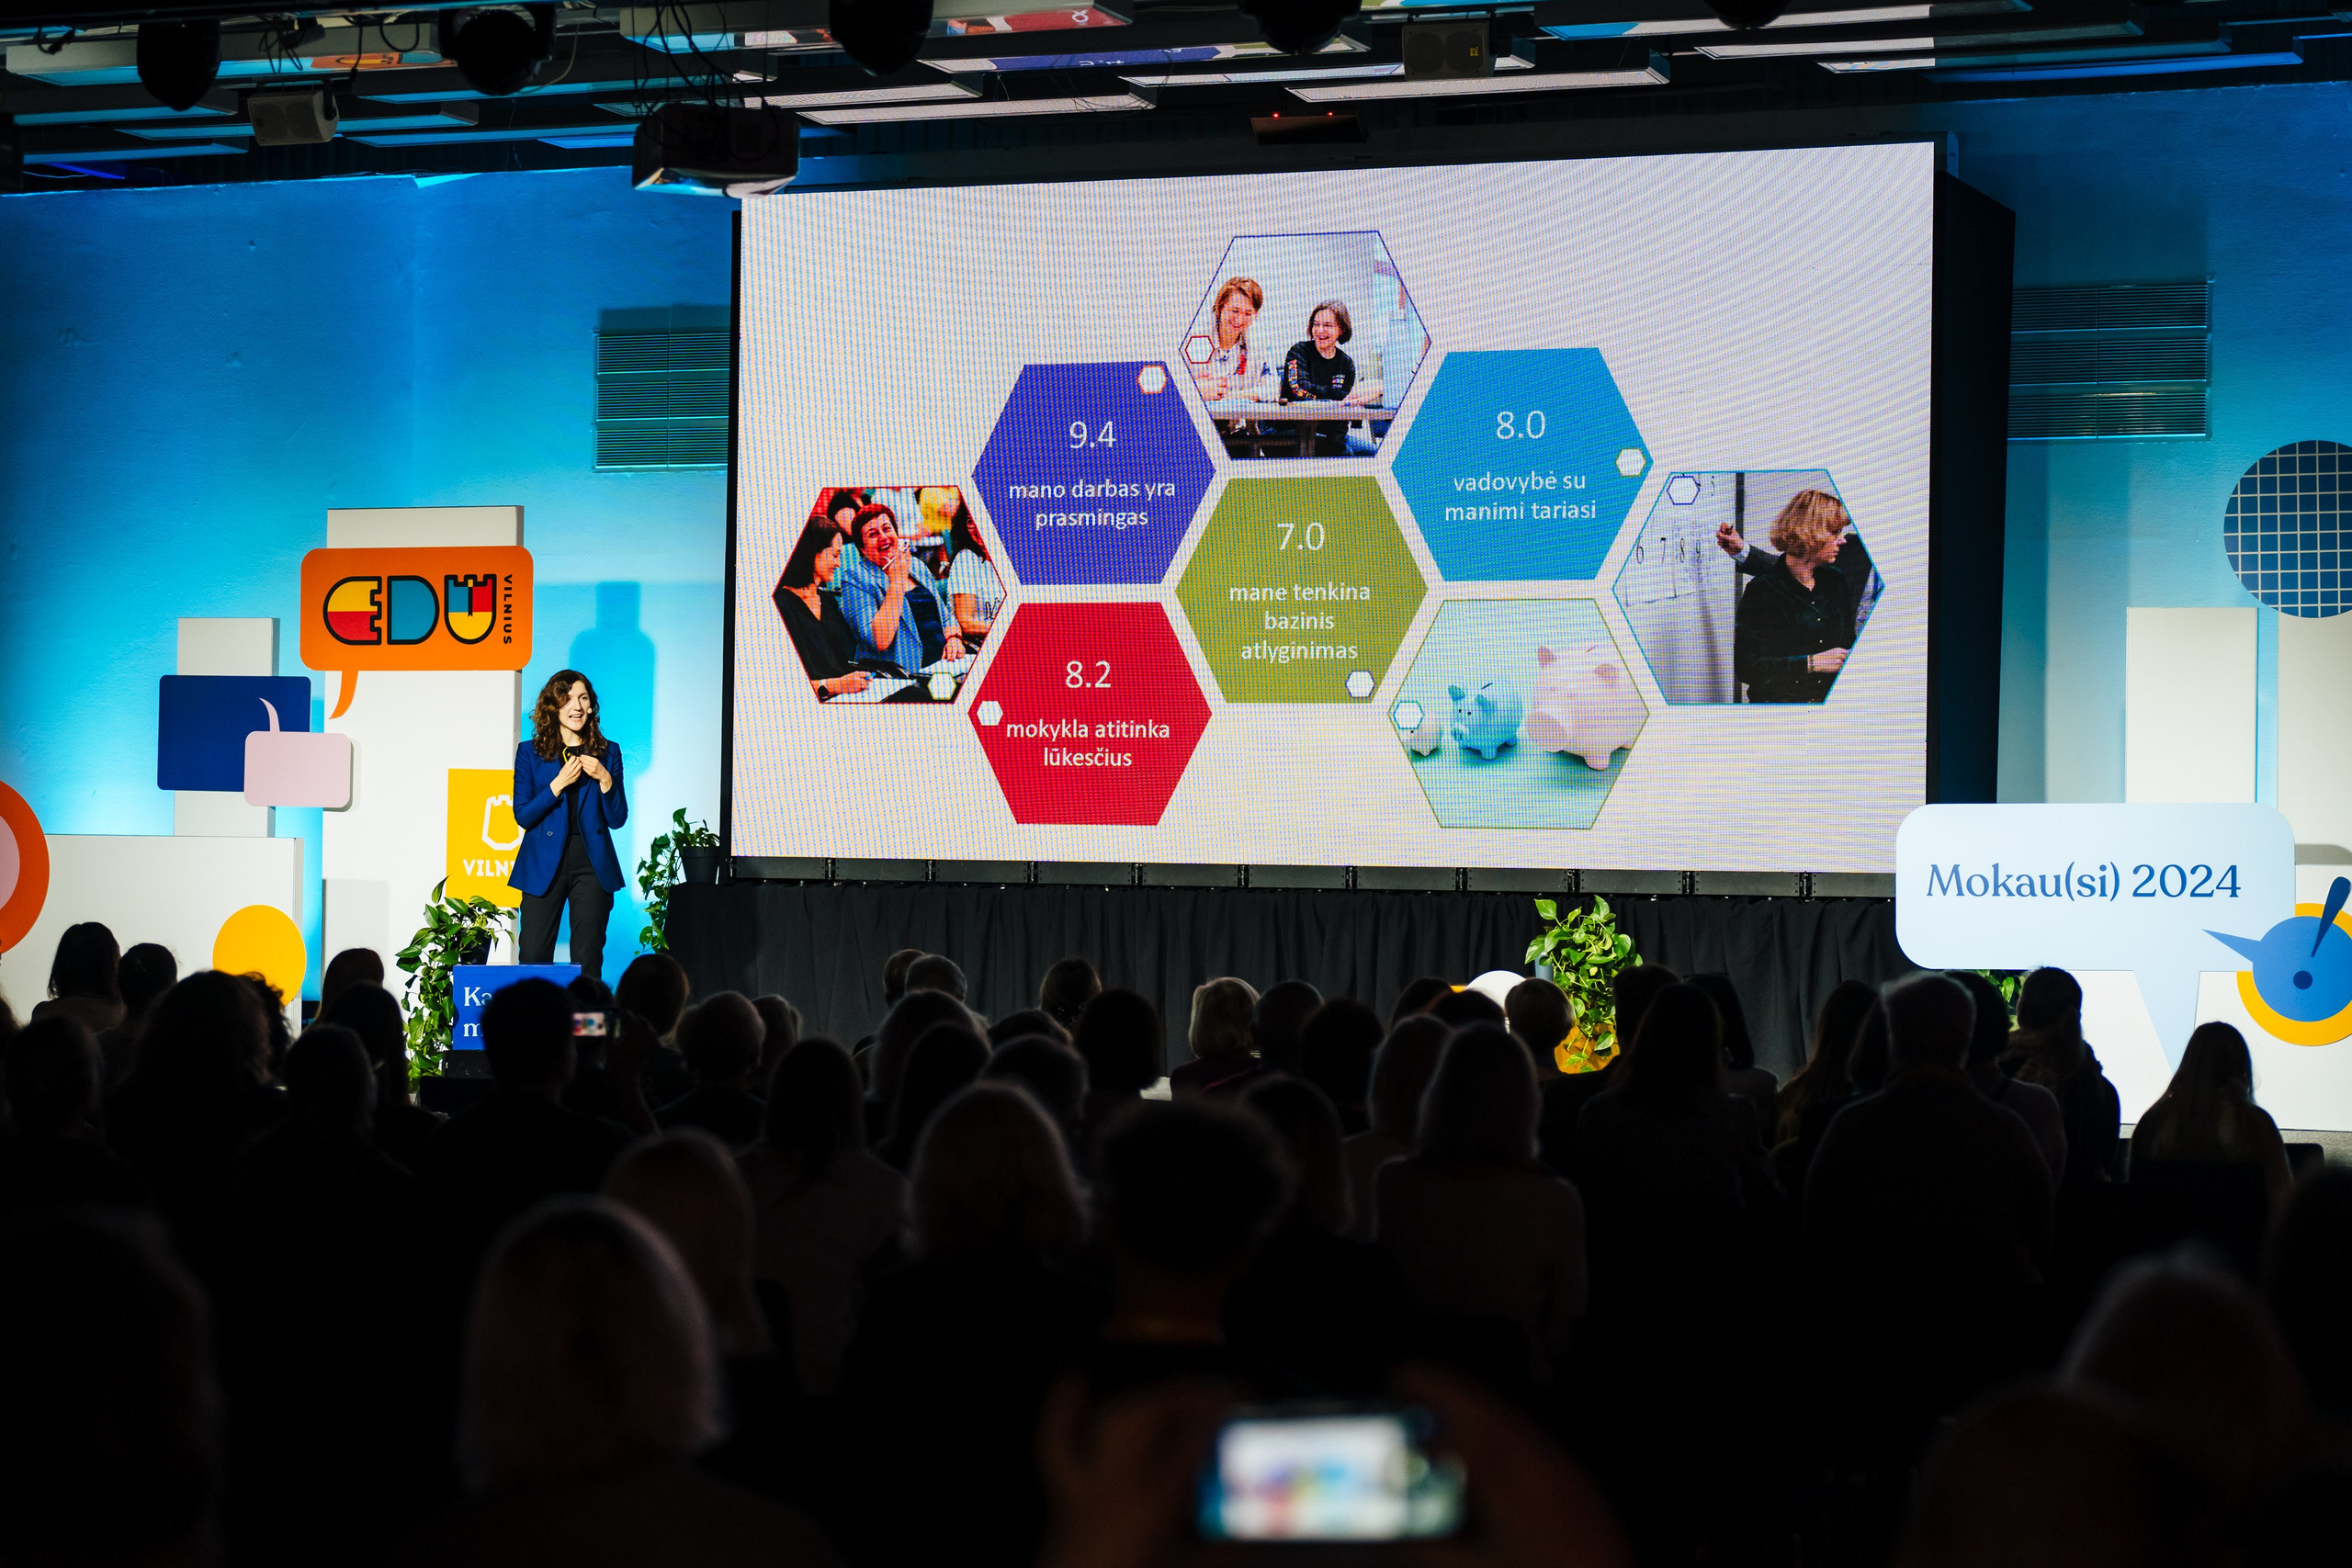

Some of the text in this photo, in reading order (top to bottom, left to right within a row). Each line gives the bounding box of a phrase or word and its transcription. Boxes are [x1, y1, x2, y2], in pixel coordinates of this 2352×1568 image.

[1069, 420, 1116, 449] 9.4
[1496, 410, 1546, 440] 8.0
[1009, 479, 1176, 502] mano darbas yra
[1453, 470, 1586, 495] vadovybė su
[1035, 508, 1149, 531] prasmingas
[1445, 500, 1596, 521] manimi tariasi
[1276, 522, 1325, 551] 7.0
[1229, 581, 1370, 602] mane tenkina
[322, 574, 497, 646] EDU
[503, 573, 513, 645] VILNIUS
[1264, 611, 1335, 630] bazinis
[1240, 639, 1359, 664] atlyginimas
[1065, 660, 1112, 689] 8.2
[1006, 718, 1170, 742] mokykla atitinka
[1044, 746, 1133, 767] lūkesčius
[1926, 862, 2242, 902] Mokau(si) 2024
